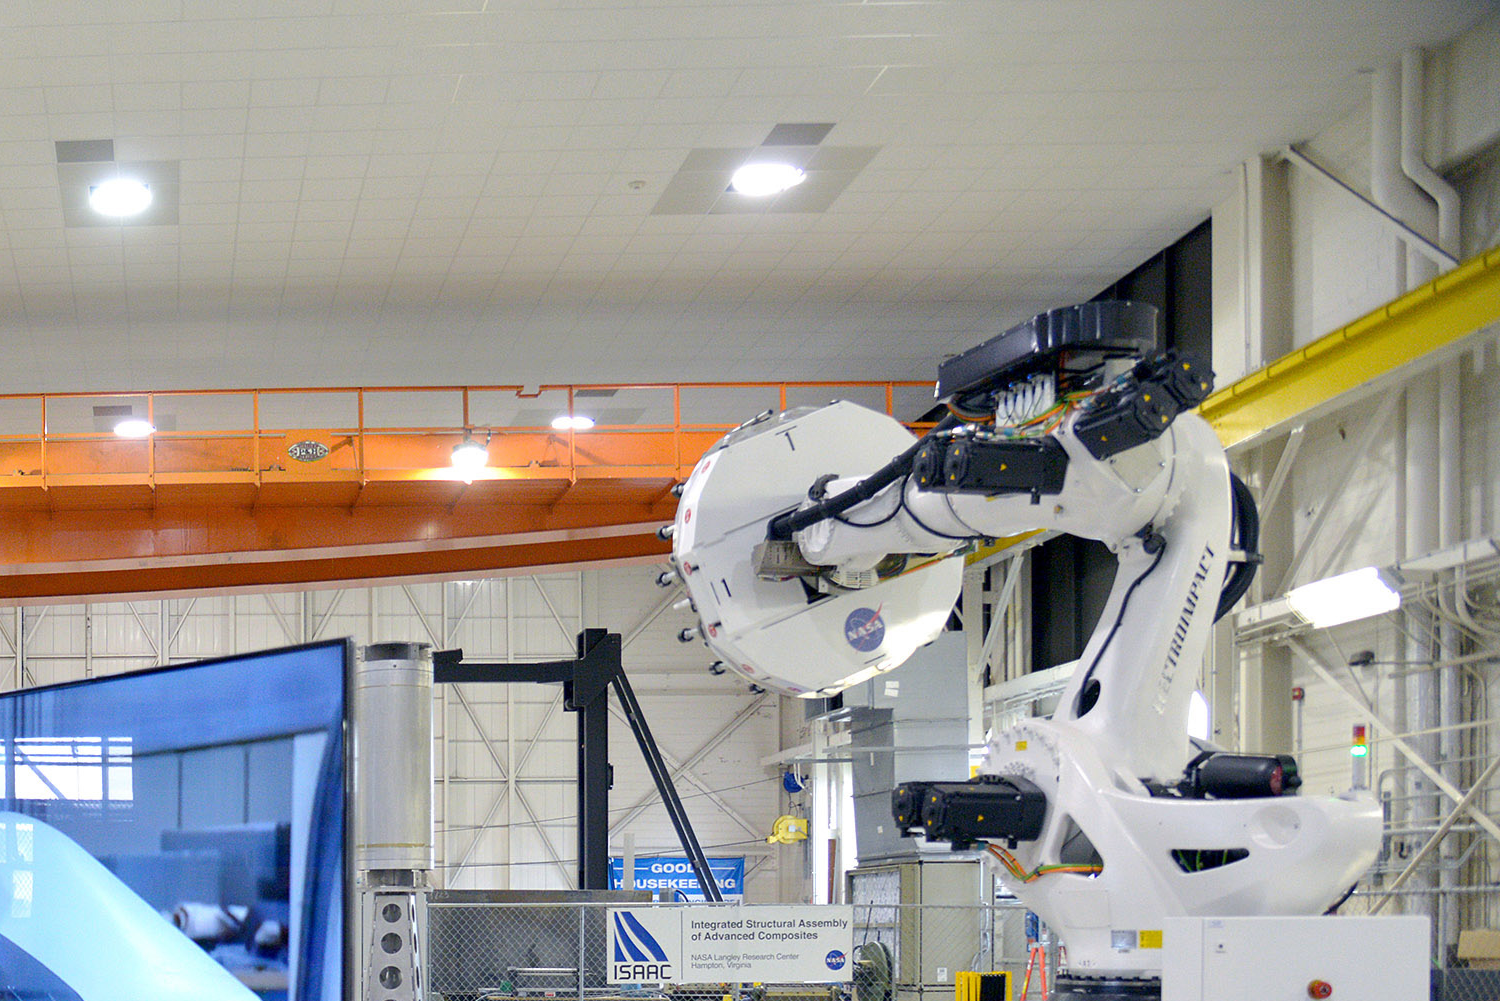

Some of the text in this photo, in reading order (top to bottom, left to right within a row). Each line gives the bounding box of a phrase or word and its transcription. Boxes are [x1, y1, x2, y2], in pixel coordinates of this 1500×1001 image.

[848, 620, 884, 641] NASA
[691, 918, 848, 931] Integrated Structural Assembly
[691, 931, 818, 942] of Advanced Composites
[714, 953, 740, 963] Langley
[742, 953, 775, 961] Research
[776, 952, 800, 961] Center
[691, 961, 752, 970] Hampton, Virginia
[614, 965, 672, 980] ISAAC
